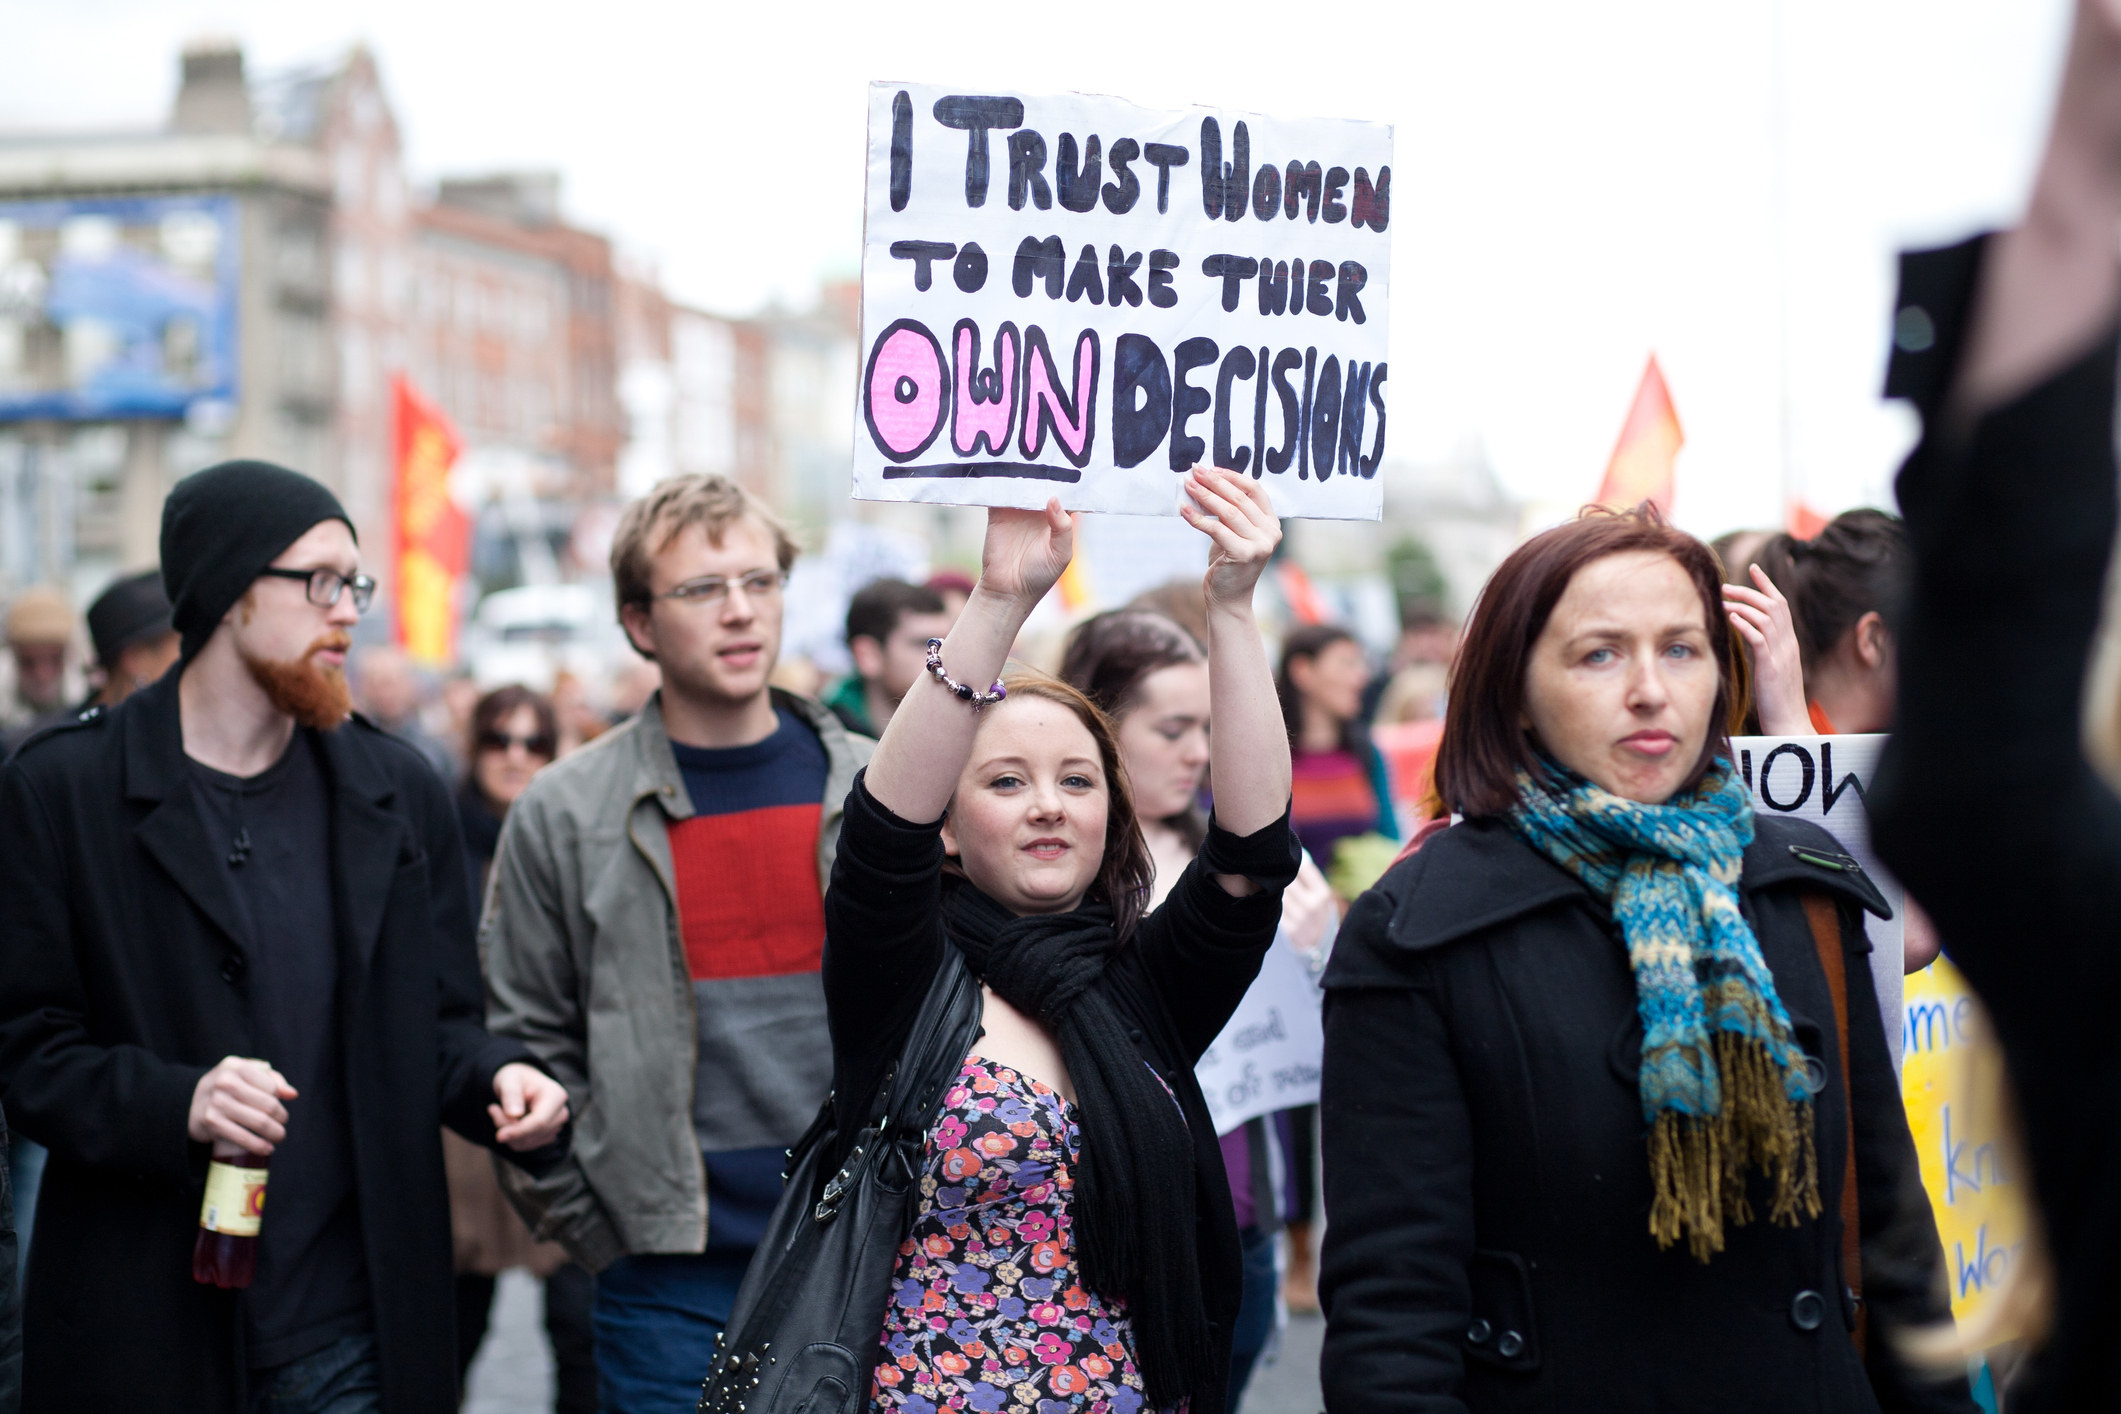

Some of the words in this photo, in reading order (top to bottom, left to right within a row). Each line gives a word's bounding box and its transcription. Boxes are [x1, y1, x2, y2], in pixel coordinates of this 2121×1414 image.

[890, 90, 913, 212] I
[933, 95, 1189, 215] TRUST
[1201, 116, 1391, 233] WOMEN
[890, 240, 988, 293] TO
[1012, 235, 1180, 308] MAKE
[1202, 253, 1368, 325] THIER
[863, 317, 1100, 468] OWN
[1112, 333, 1388, 483] DECISIONS
